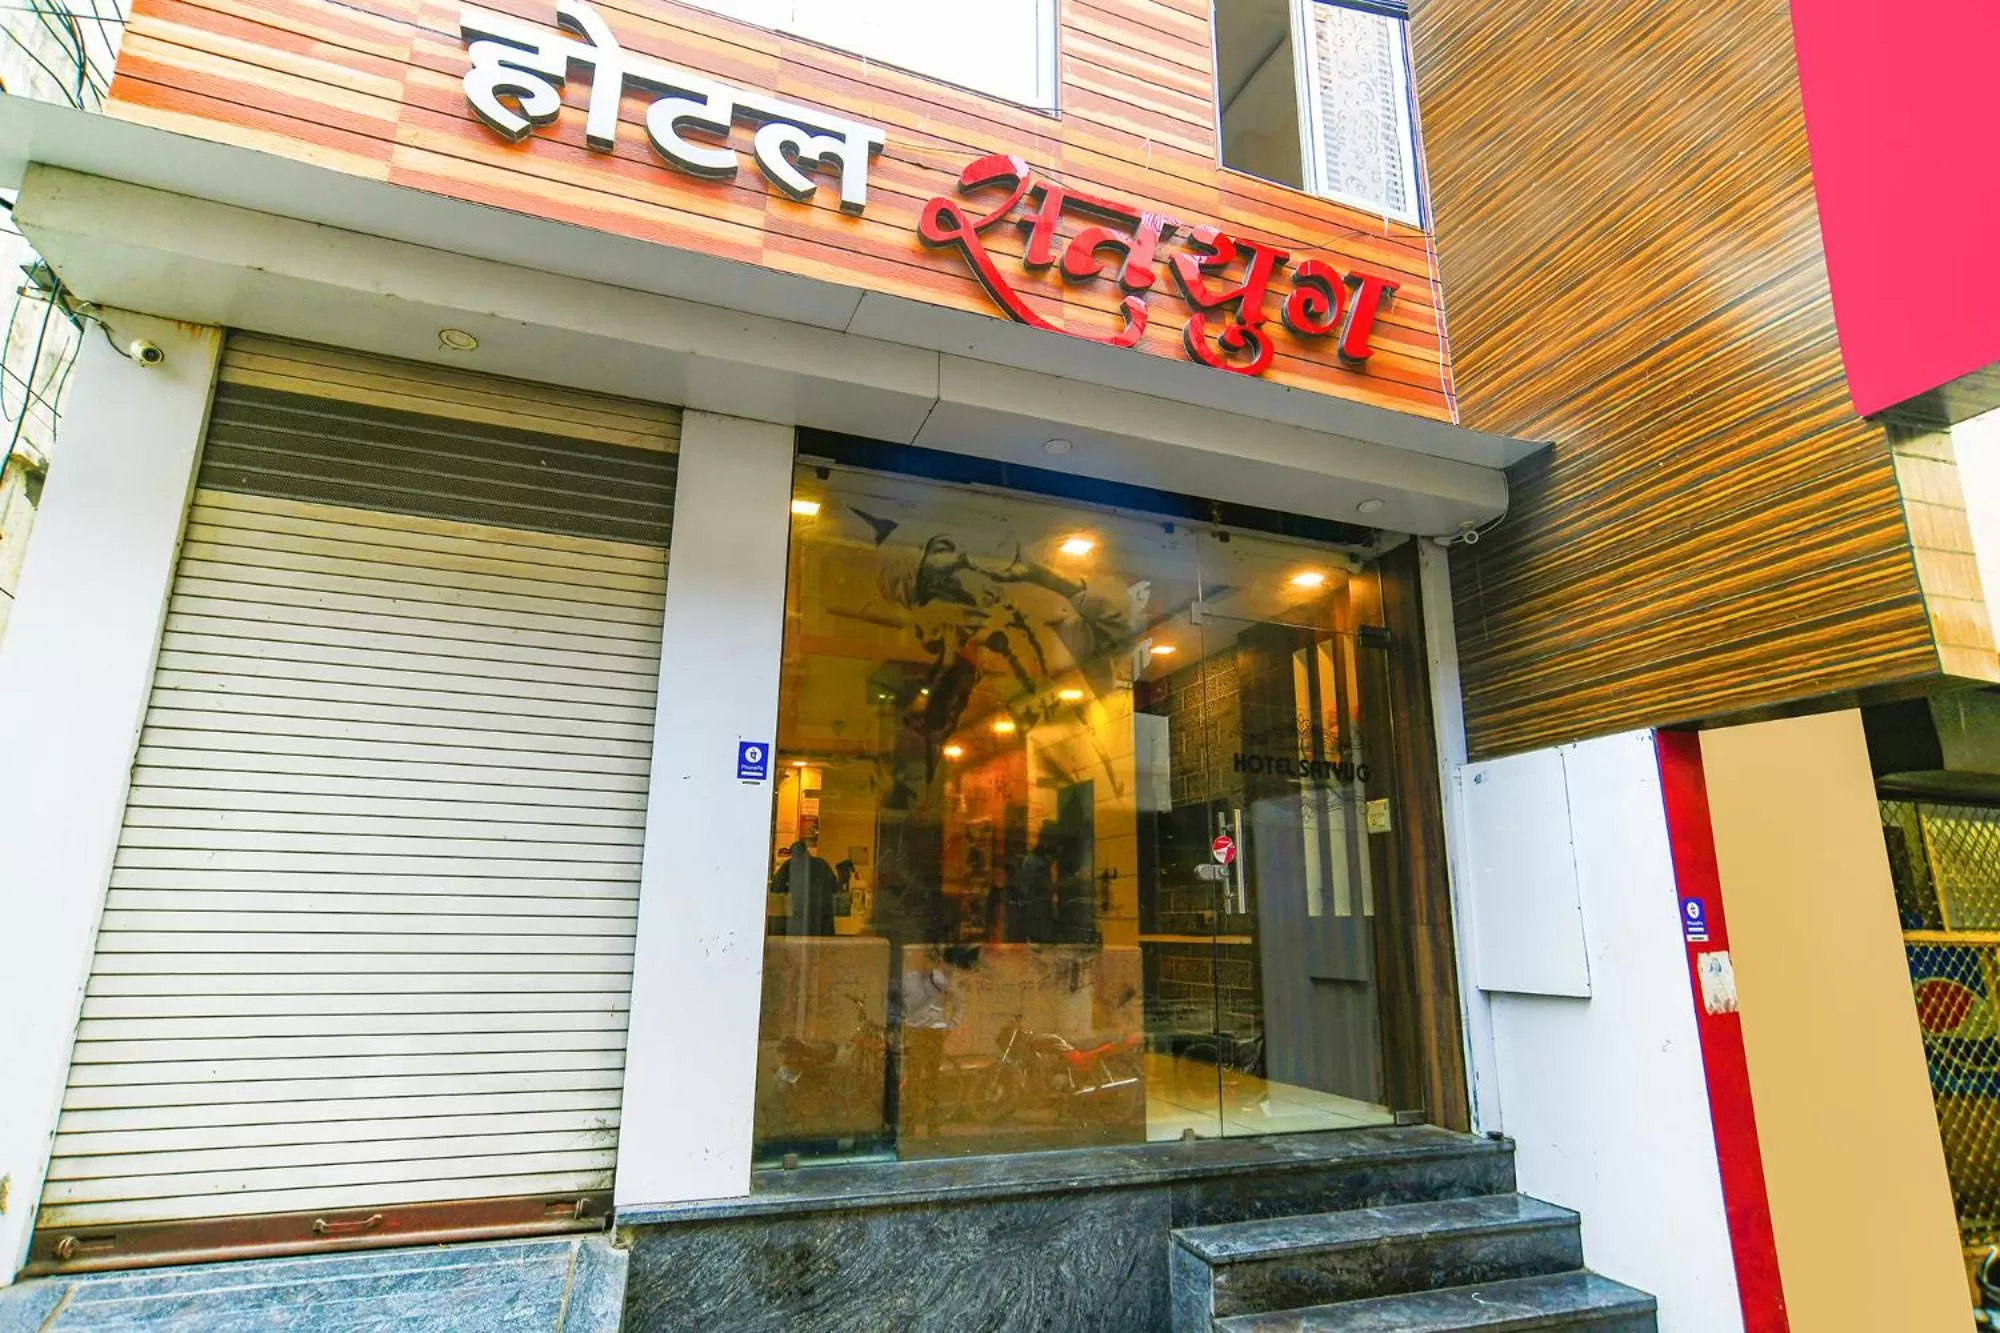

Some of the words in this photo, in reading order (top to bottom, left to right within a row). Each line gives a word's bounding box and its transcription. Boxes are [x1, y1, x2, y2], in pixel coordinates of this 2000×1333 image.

[460, 0, 885, 216] होटल
[1233, 753, 1297, 776] HOTEL
[1299, 760, 1370, 783] SATYUG
